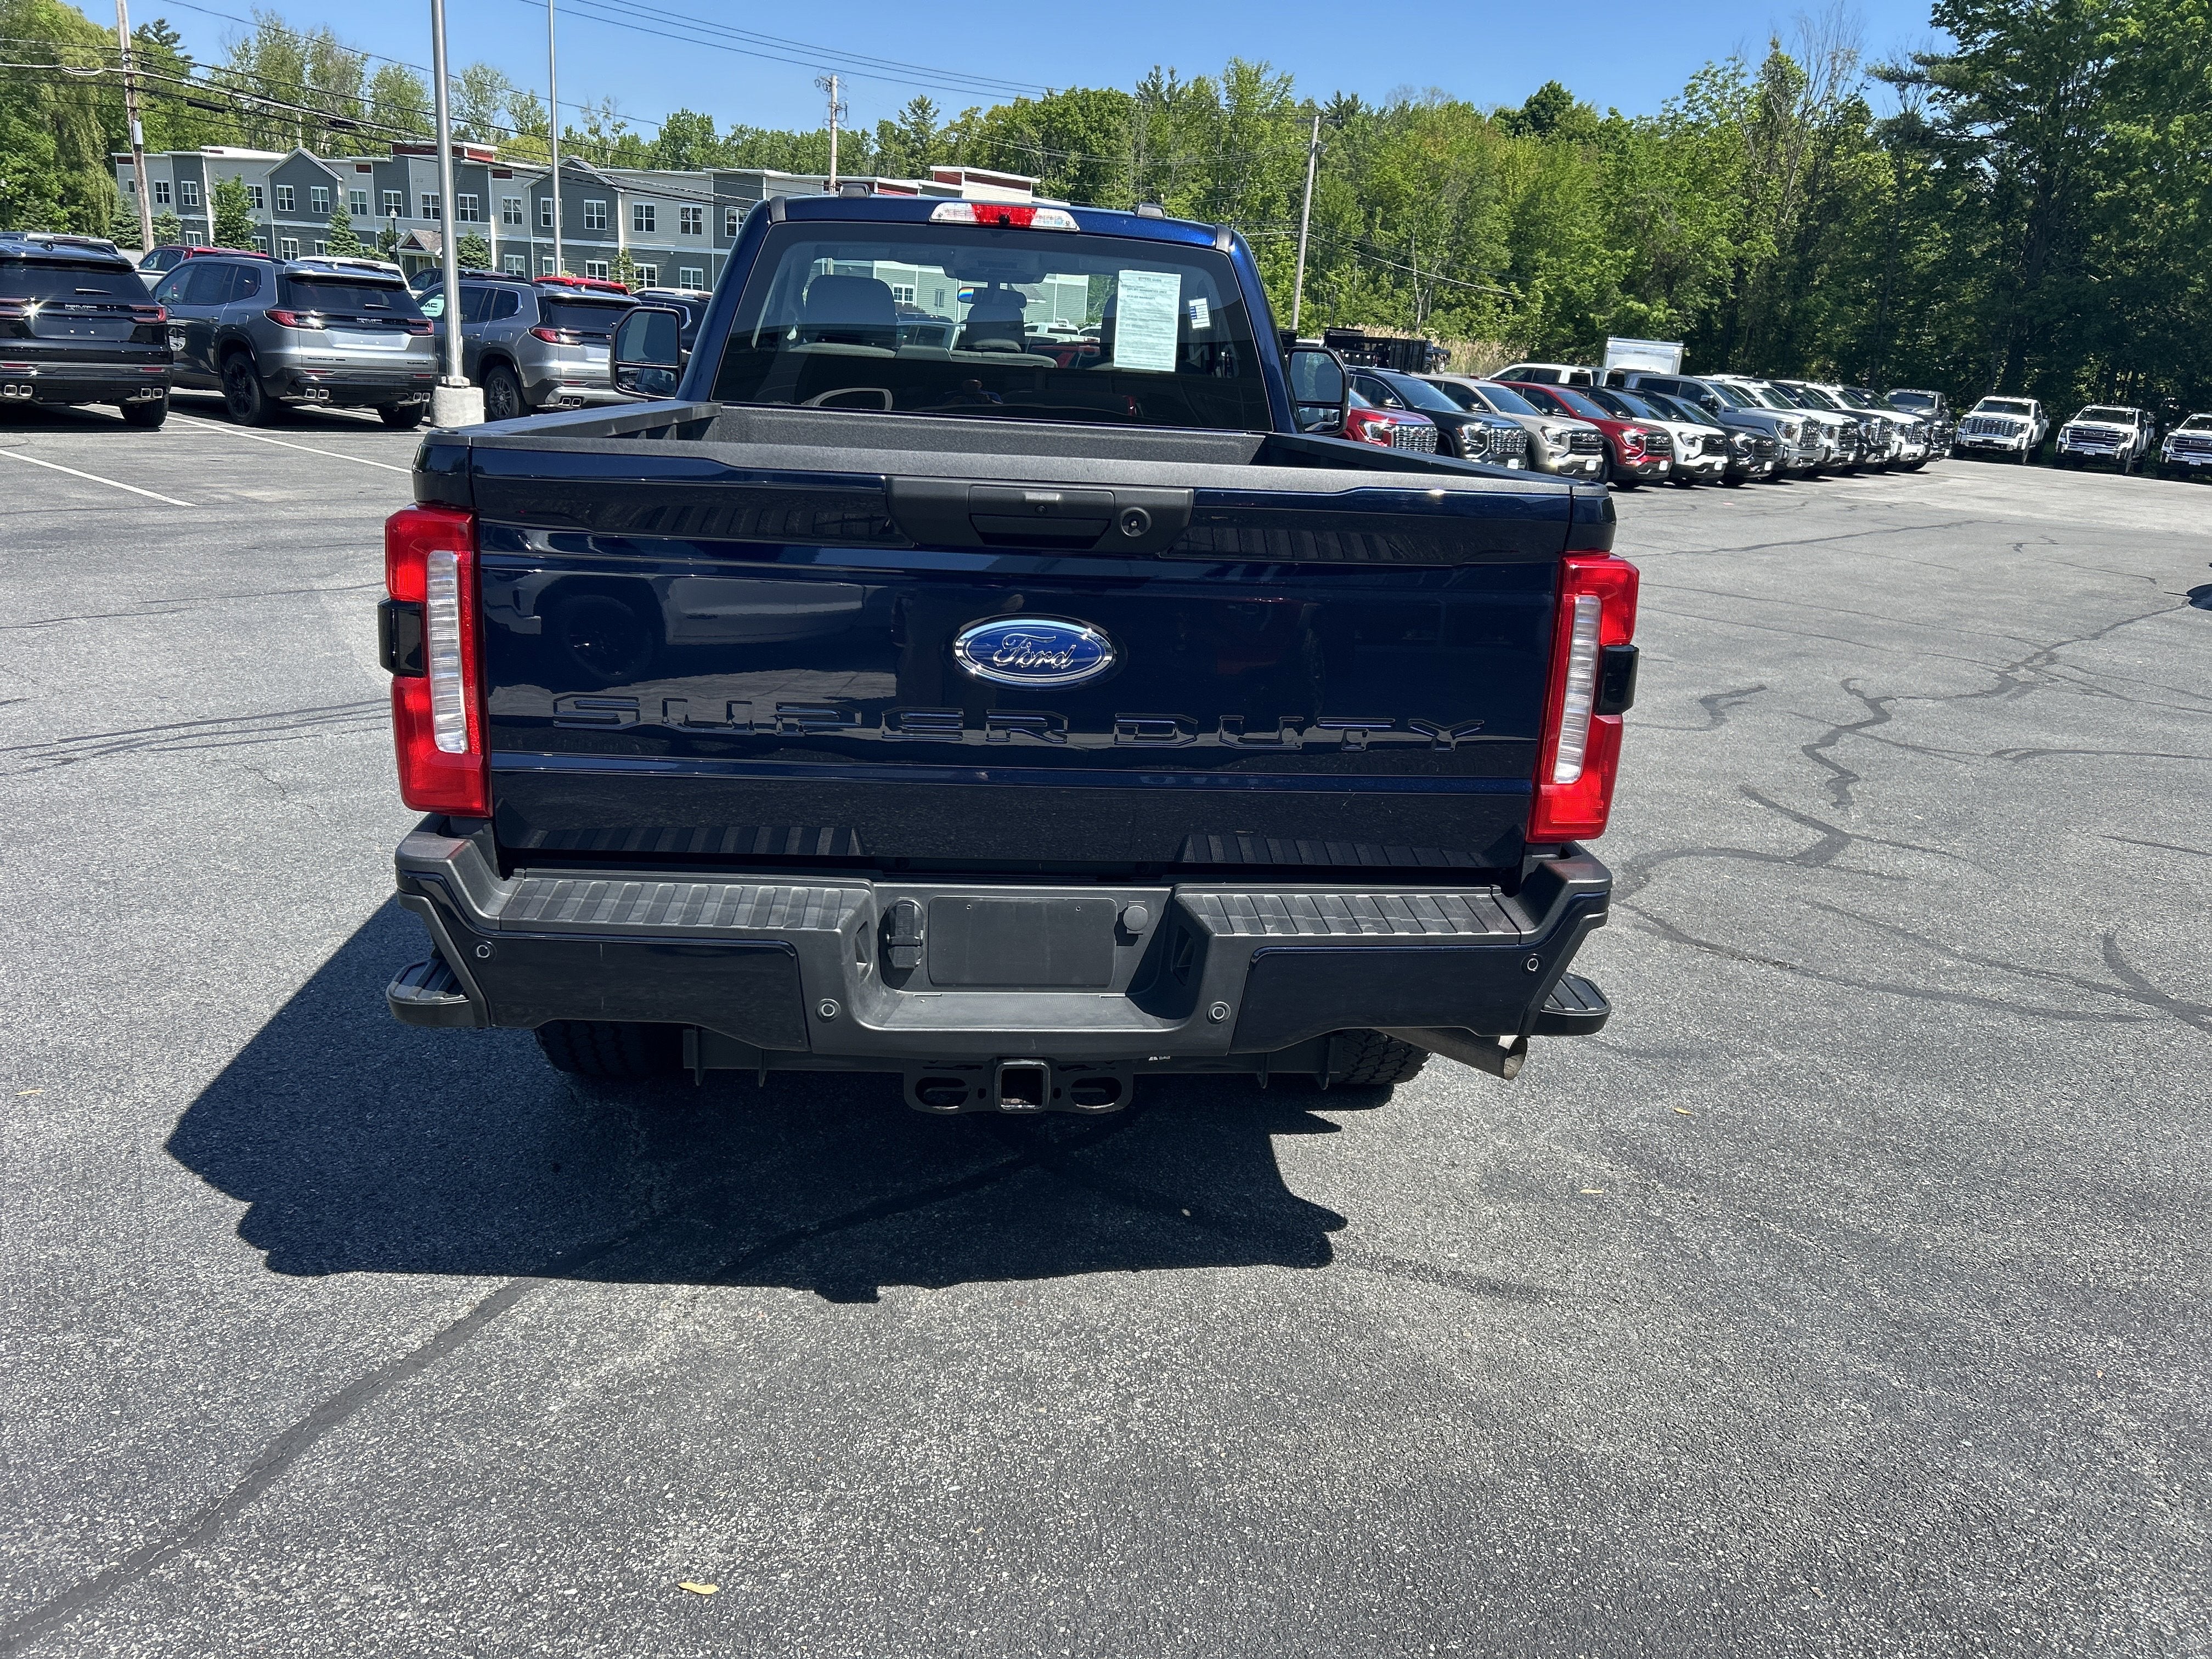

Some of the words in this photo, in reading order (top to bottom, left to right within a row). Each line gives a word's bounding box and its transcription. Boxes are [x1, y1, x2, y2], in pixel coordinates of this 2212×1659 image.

[992, 633, 1077, 669] Ford
[552, 695, 1068, 744] SUPER
[1114, 713, 1485, 752] DUTY
